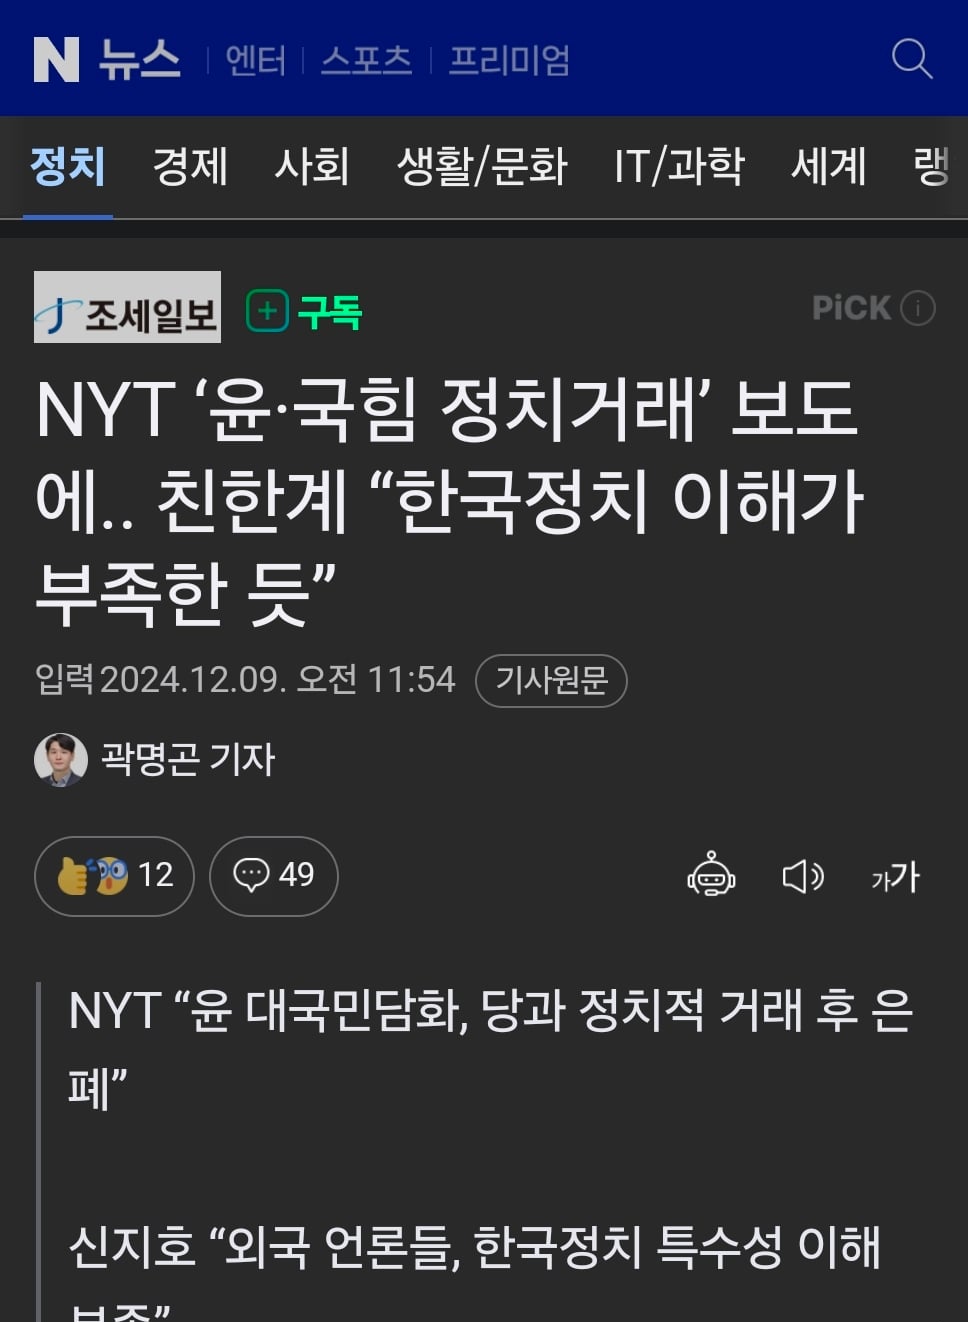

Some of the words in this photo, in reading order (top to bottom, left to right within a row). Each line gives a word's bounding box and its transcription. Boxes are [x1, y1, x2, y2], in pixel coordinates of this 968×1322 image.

[33, 36, 80, 83] N
[99, 38, 181, 80] 뉴스
[227, 45, 284, 76] 엔터
[321, 45, 412, 74] 스포츠
[449, 45, 568, 76] 프리미엄
[30, 146, 103, 186] 정치
[154, 147, 226, 186] 경제
[275, 147, 347, 186] 사회
[397, 144, 568, 187] 생활/문화
[617, 144, 745, 187] IT/과학
[791, 147, 864, 186] 세계
[86, 299, 217, 334] 조세일보
[298, 295, 362, 330] 구독
[814, 294, 890, 319] PiCK
[40, 382, 176, 436] NYT
[732, 381, 858, 434] 보도
[158, 469, 344, 534] 친한계
[675, 469, 864, 534] 이해가
[36, 562, 228, 628] 부족한
[36, 663, 94, 695] 입력
[100, 664, 286, 694] 2024.12.09.
[297, 664, 356, 694] 오전
[369, 666, 456, 692] 11:54
[497, 666, 608, 695] 기사원문
[102, 742, 200, 777] 곽명곤
[210, 742, 275, 777] 기자
[139, 862, 173, 886] 12
[279, 862, 313, 886] 49
[71, 992, 162, 1028] NYT
[247, 988, 467, 1036] 대국민담화,
[483, 988, 566, 1033] 당과
[579, 988, 702, 1033] 정치적
[721, 988, 801, 1032] 거래
[817, 989, 858, 1032] 후
[872, 990, 913, 1032] 은
[69, 1226, 196, 1269] 신지호
[326, 1226, 459, 1273] 언론들,
[474, 1226, 640, 1270] 한국정치
[657, 1226, 781, 1270] 특수성
[799, 1226, 879, 1269] 이해
